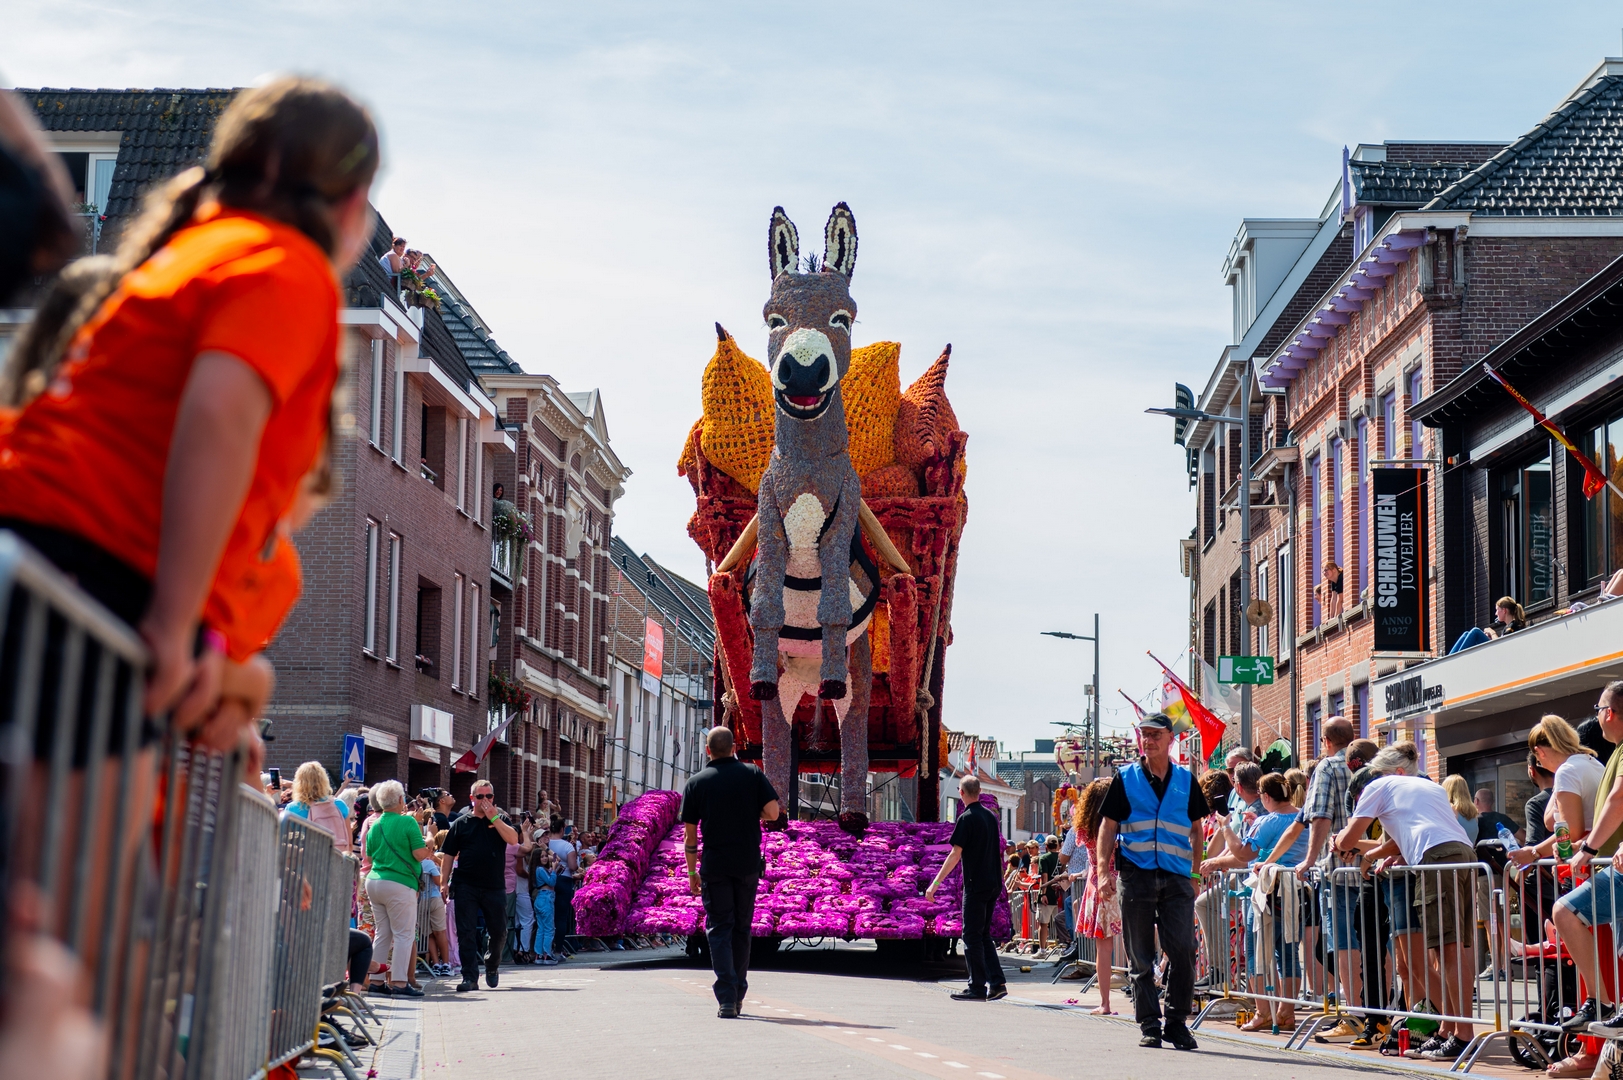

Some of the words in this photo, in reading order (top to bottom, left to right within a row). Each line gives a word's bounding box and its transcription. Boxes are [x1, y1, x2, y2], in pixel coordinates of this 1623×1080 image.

[1377, 494, 1398, 608] SCHRAUWEN
[1400, 511, 1416, 591] JUWELIER
[1381, 616, 1413, 626] ANNO
[1387, 626, 1409, 636] 1927
